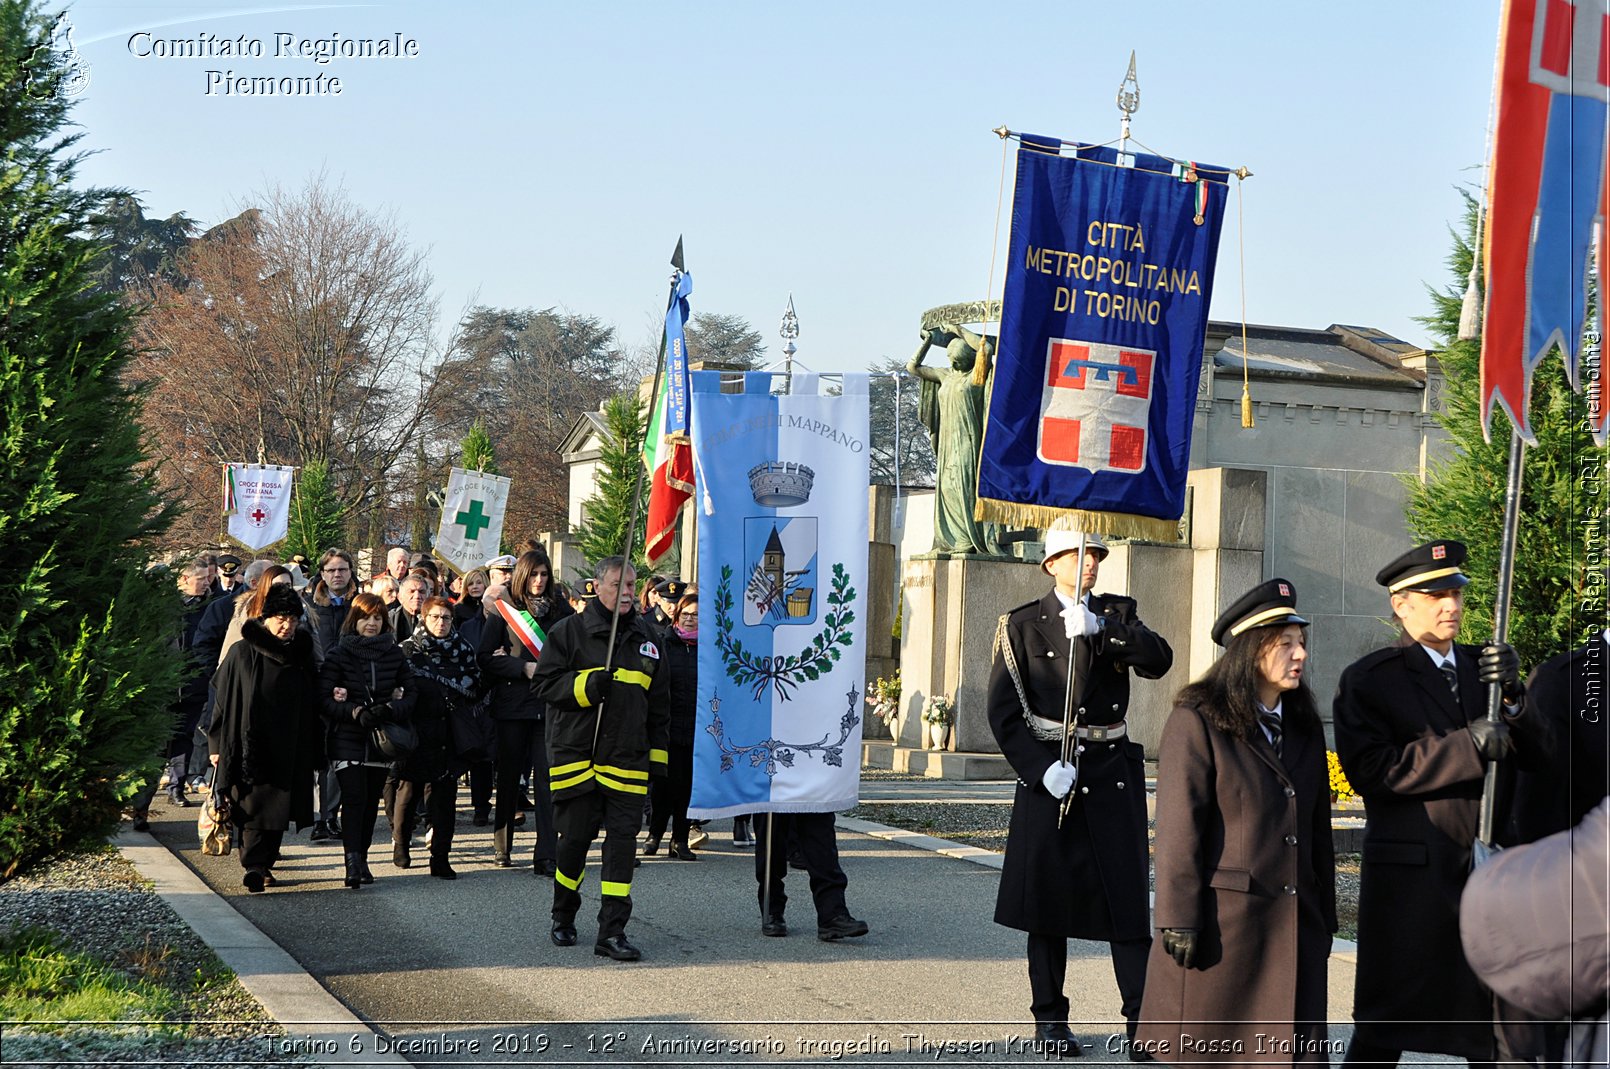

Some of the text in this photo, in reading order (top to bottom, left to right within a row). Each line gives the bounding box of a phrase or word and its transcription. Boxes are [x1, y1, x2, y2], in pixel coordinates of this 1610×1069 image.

[1087, 220, 1146, 253] CITTÀ
[1025, 245, 1201, 296] METROPOLITANA
[1054, 286, 1161, 326] DI TORINO
[788, 415, 863, 453] MAPPANO
[238, 480, 258, 488] CROCE
[454, 482, 500, 502] CROCE VERDE
[450, 548, 484, 560] TORINO
